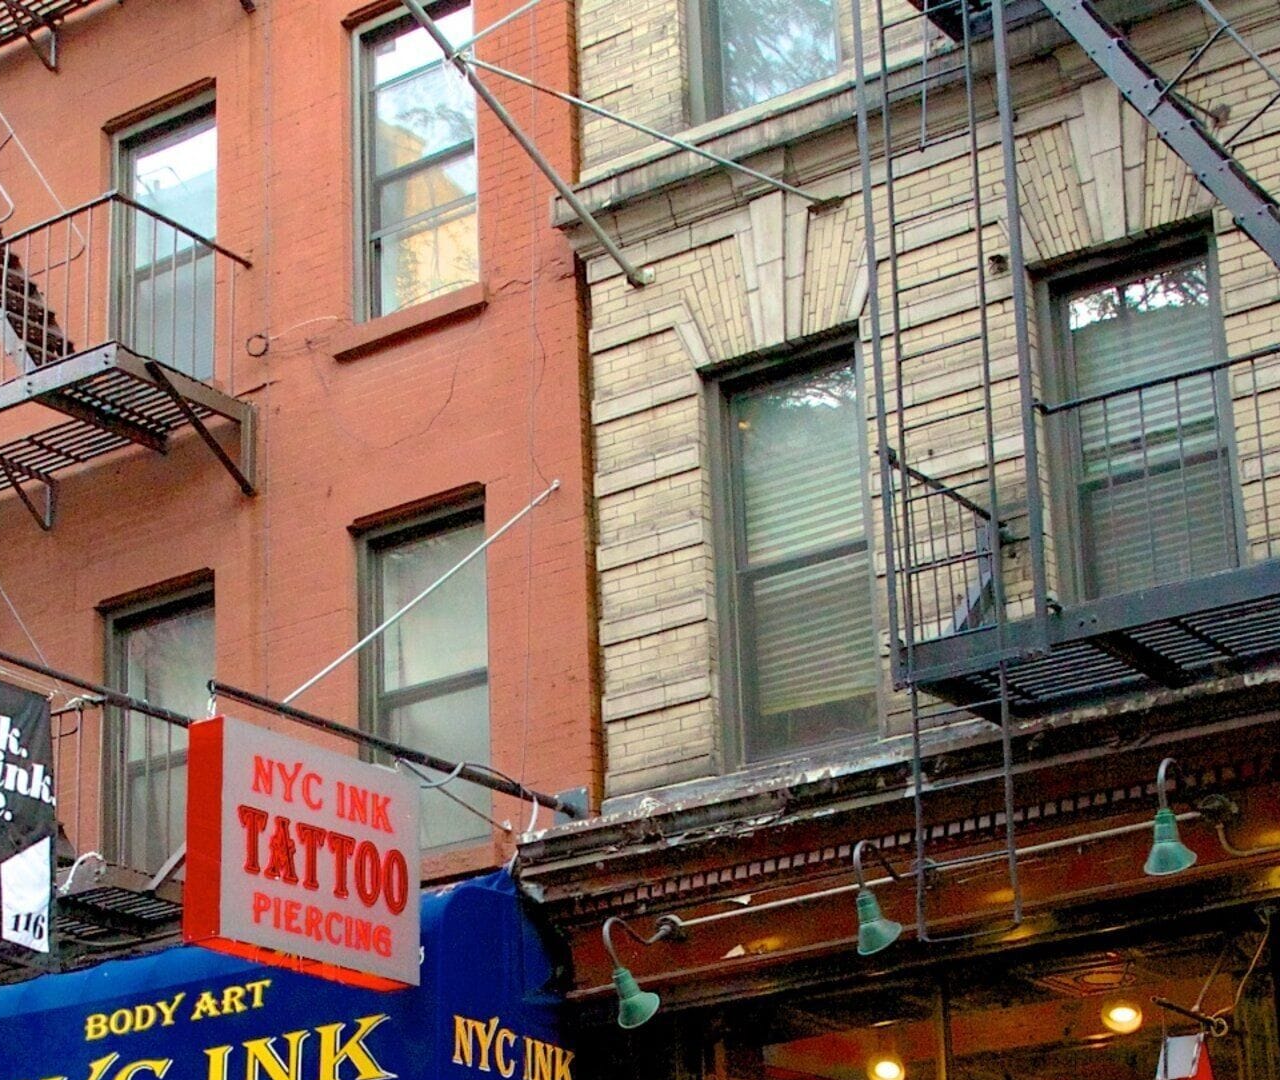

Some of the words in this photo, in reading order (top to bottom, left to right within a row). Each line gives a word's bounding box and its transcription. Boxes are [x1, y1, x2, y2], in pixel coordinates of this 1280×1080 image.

[252, 754, 324, 811] NYC
[336, 781, 395, 834] INK
[237, 804, 409, 915] TATTOO
[10, 911, 45, 942] 116
[252, 891, 392, 958] PIERCING
[84, 991, 184, 1043] BODY
[192, 977, 273, 1017] ART
[452, 1015, 518, 1078] NYC
